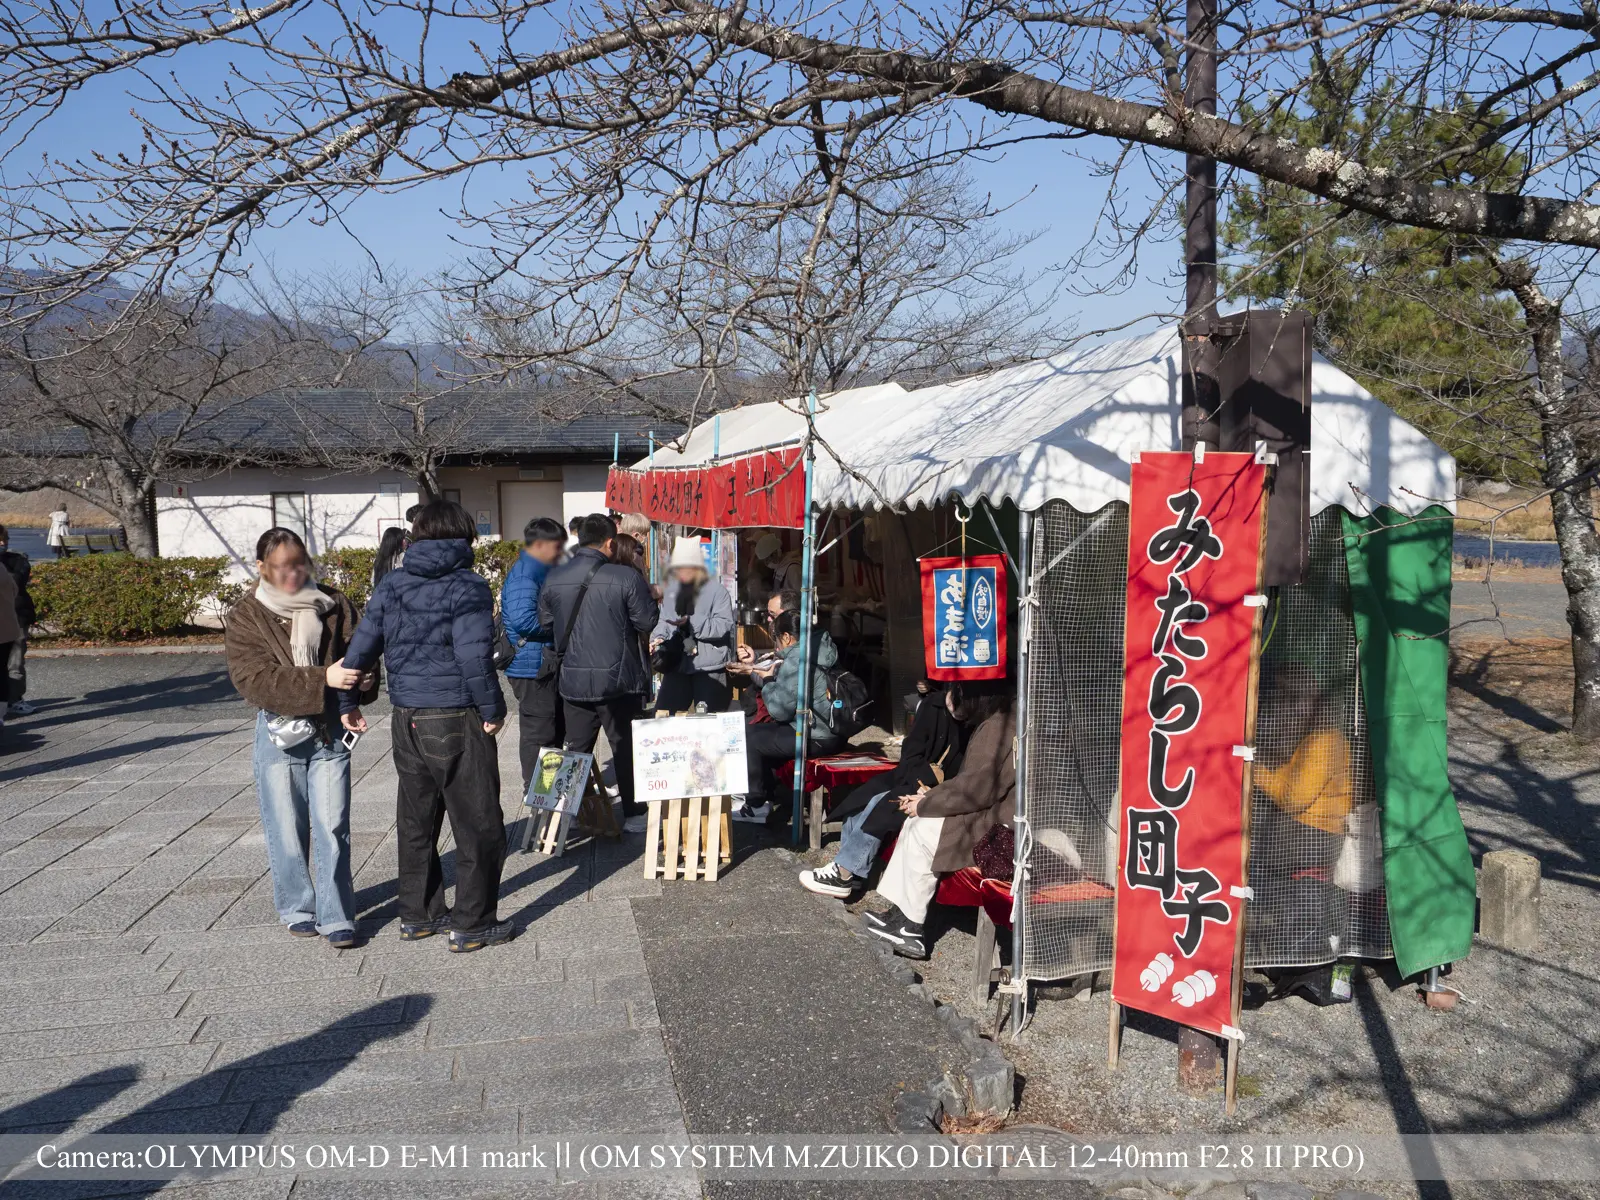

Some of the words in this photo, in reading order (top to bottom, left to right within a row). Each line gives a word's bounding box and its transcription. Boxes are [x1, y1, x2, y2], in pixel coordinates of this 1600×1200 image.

[648, 779, 668, 791] 500
[1126, 487, 1232, 957] みたらし団子
